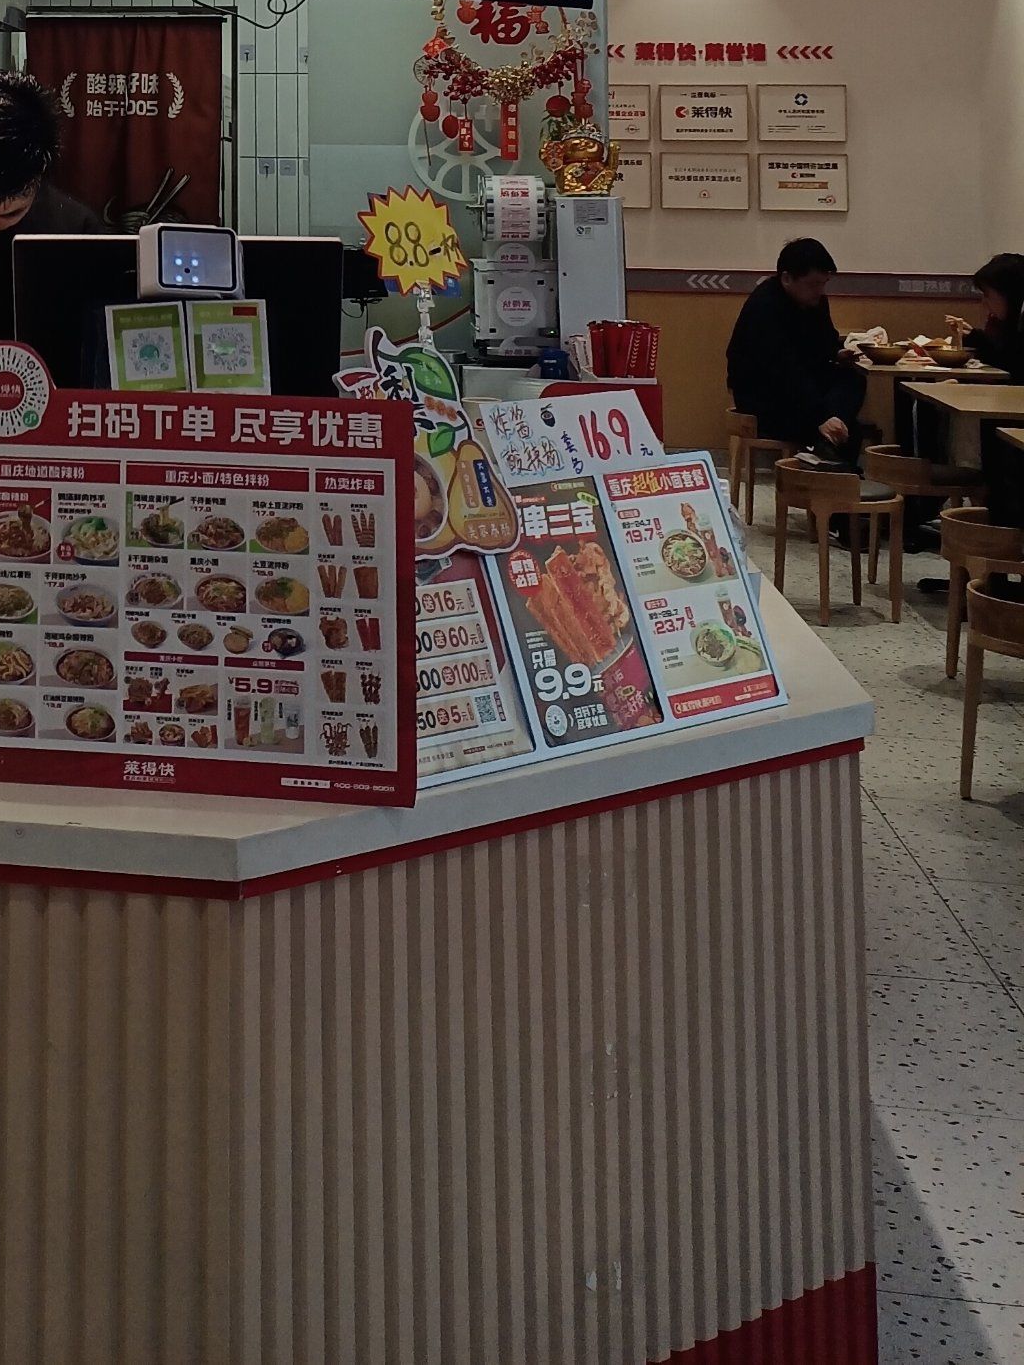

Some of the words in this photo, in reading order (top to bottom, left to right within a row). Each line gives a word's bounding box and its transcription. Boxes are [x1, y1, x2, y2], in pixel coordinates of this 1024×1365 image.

[86, 72, 159, 95] 酸辣好味
[691, 106, 733, 119] 莱得快
[68, 401, 216, 442] 扫码下单
[231, 407, 383, 449] 尽享优惠
[578, 408, 633, 461] 16.9
[0, 464, 86, 480] 重庆地道酸辣粉
[165, 470, 270, 487] 重庆小面/特色拌粉
[608, 469, 705, 496] 重庆超值小面套餐
[518, 501, 597, 539] 串三宝
[123, 760, 176, 777] 莱得快
